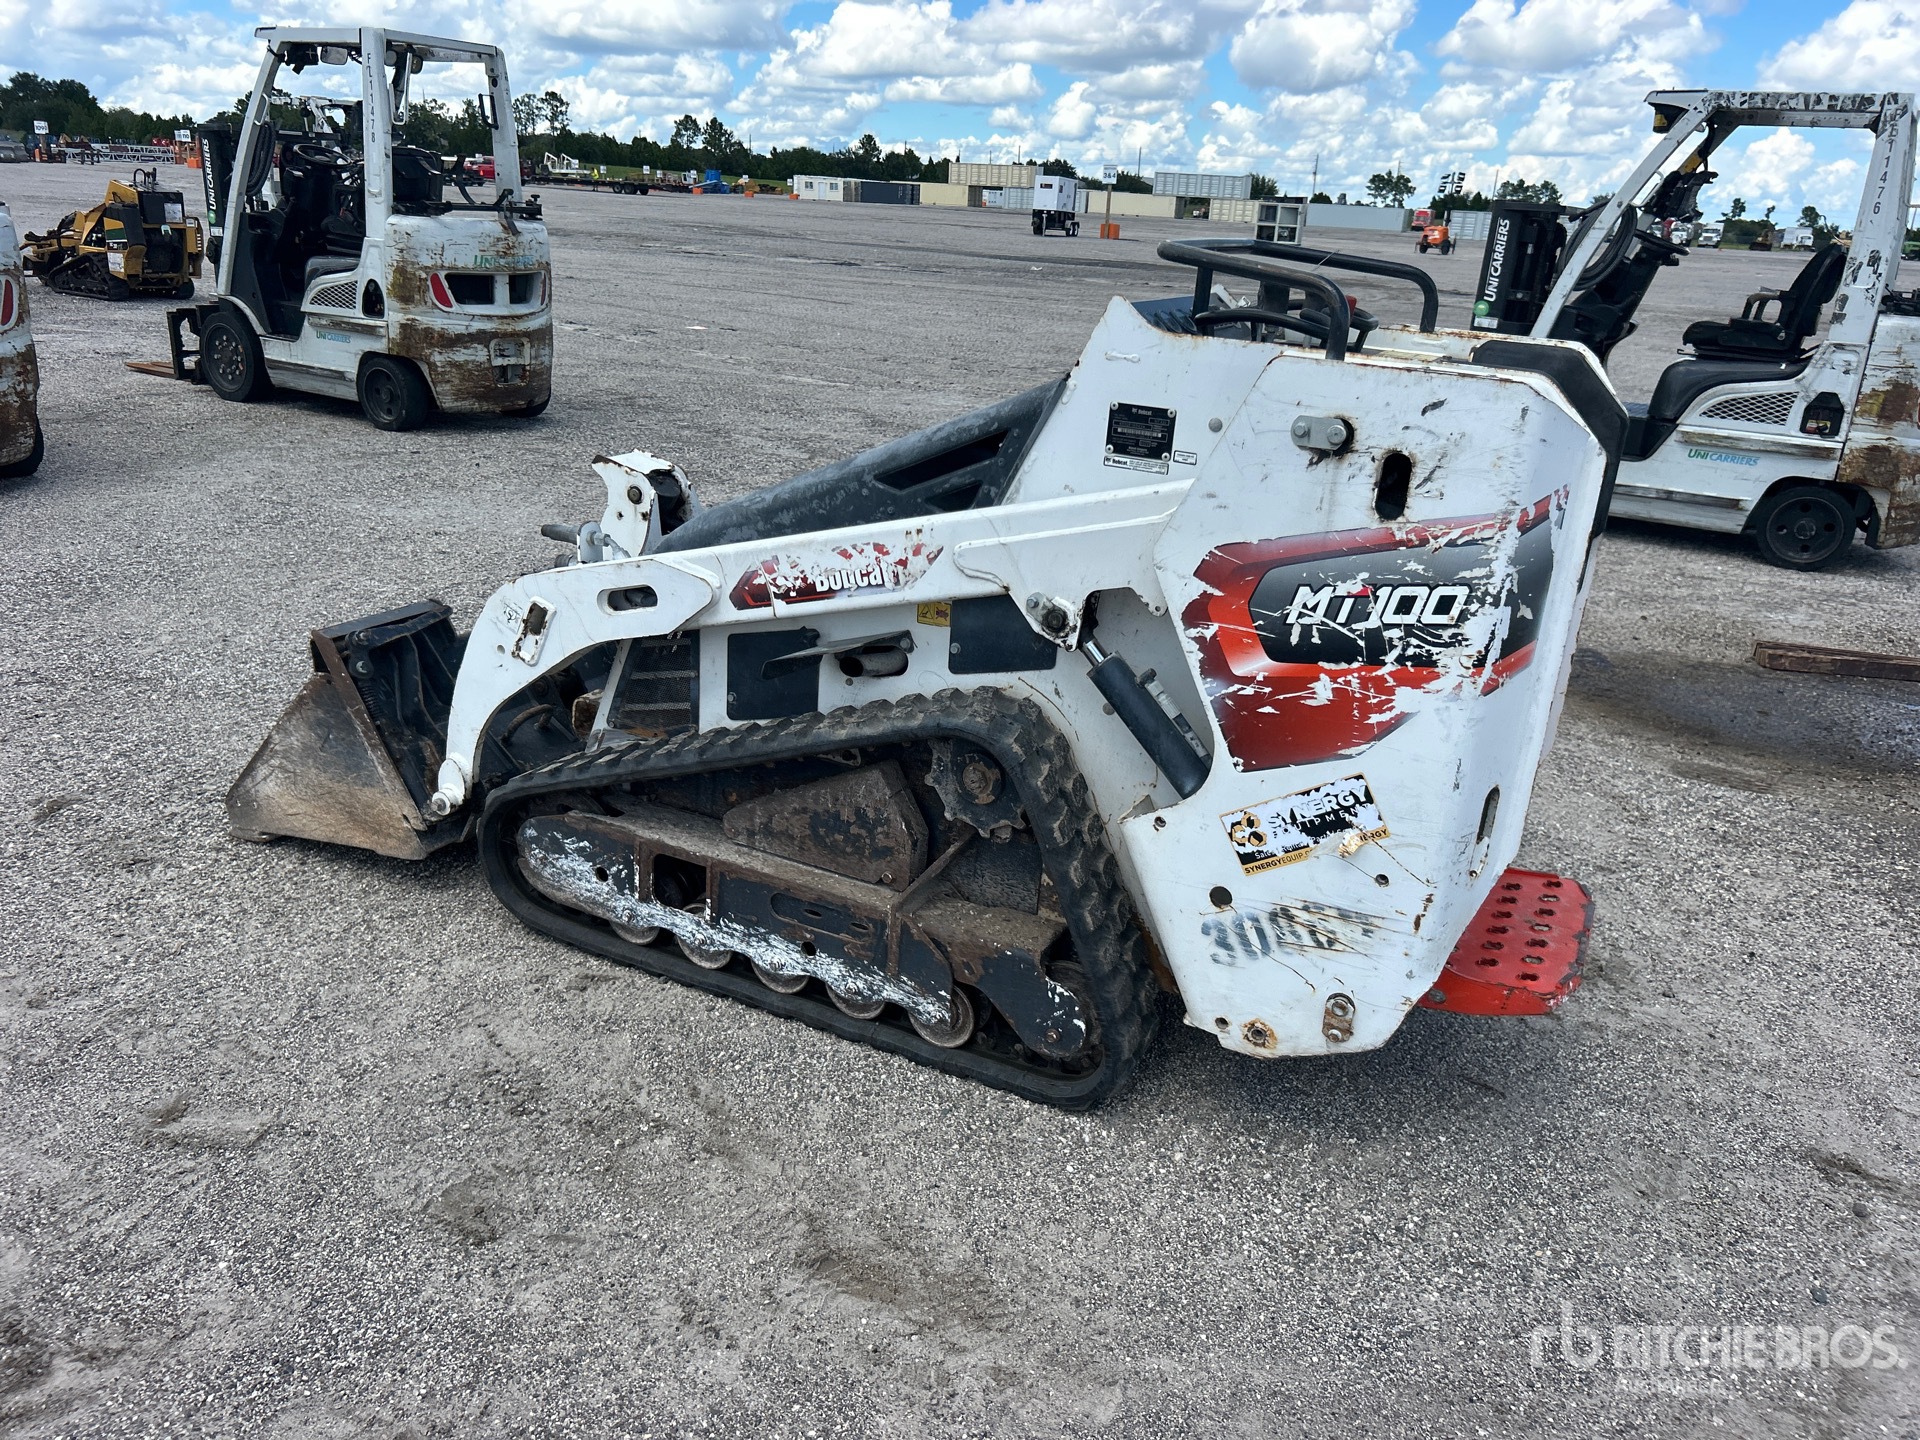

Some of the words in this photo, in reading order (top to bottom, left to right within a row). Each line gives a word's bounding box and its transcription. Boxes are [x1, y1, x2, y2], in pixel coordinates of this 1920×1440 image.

[202, 138, 217, 210] UNICARRIERS
[1483, 217, 1510, 302] UNICARRIERS
[1687, 448, 1760, 467] UNICARRIERS
[1286, 583, 1472, 625] MT100
